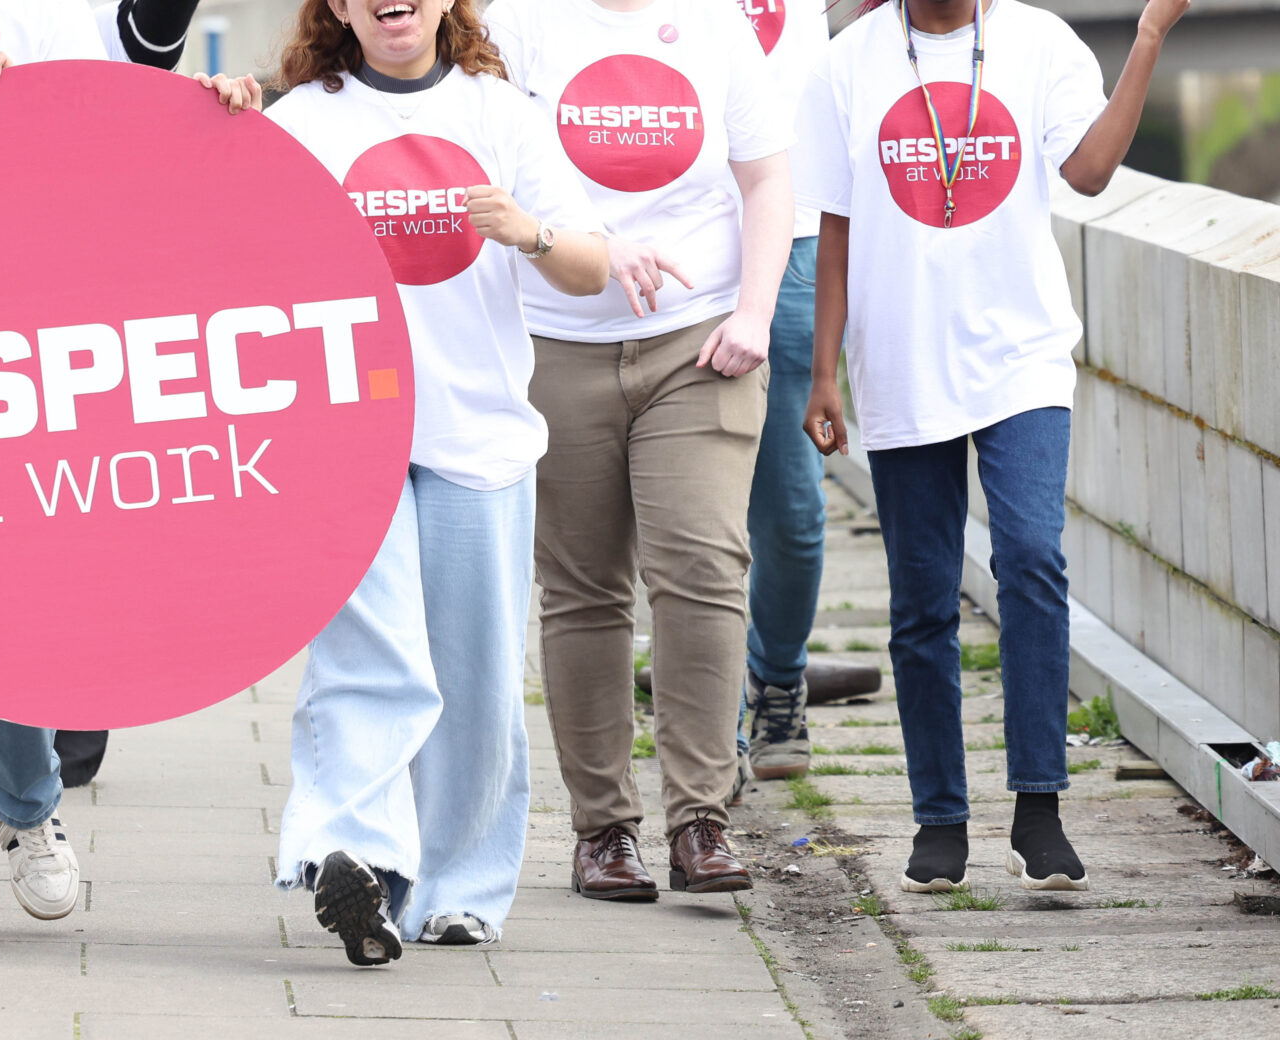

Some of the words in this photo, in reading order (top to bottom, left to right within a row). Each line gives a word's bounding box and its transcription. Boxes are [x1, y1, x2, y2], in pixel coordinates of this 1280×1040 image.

[560, 103, 702, 131] RESPECT.
[588, 129, 612, 145] at
[613, 129, 675, 146] work
[906, 166, 928, 182] at
[374, 220, 398, 237] at
[403, 214, 464, 235] work
[24, 424, 279, 517] work
